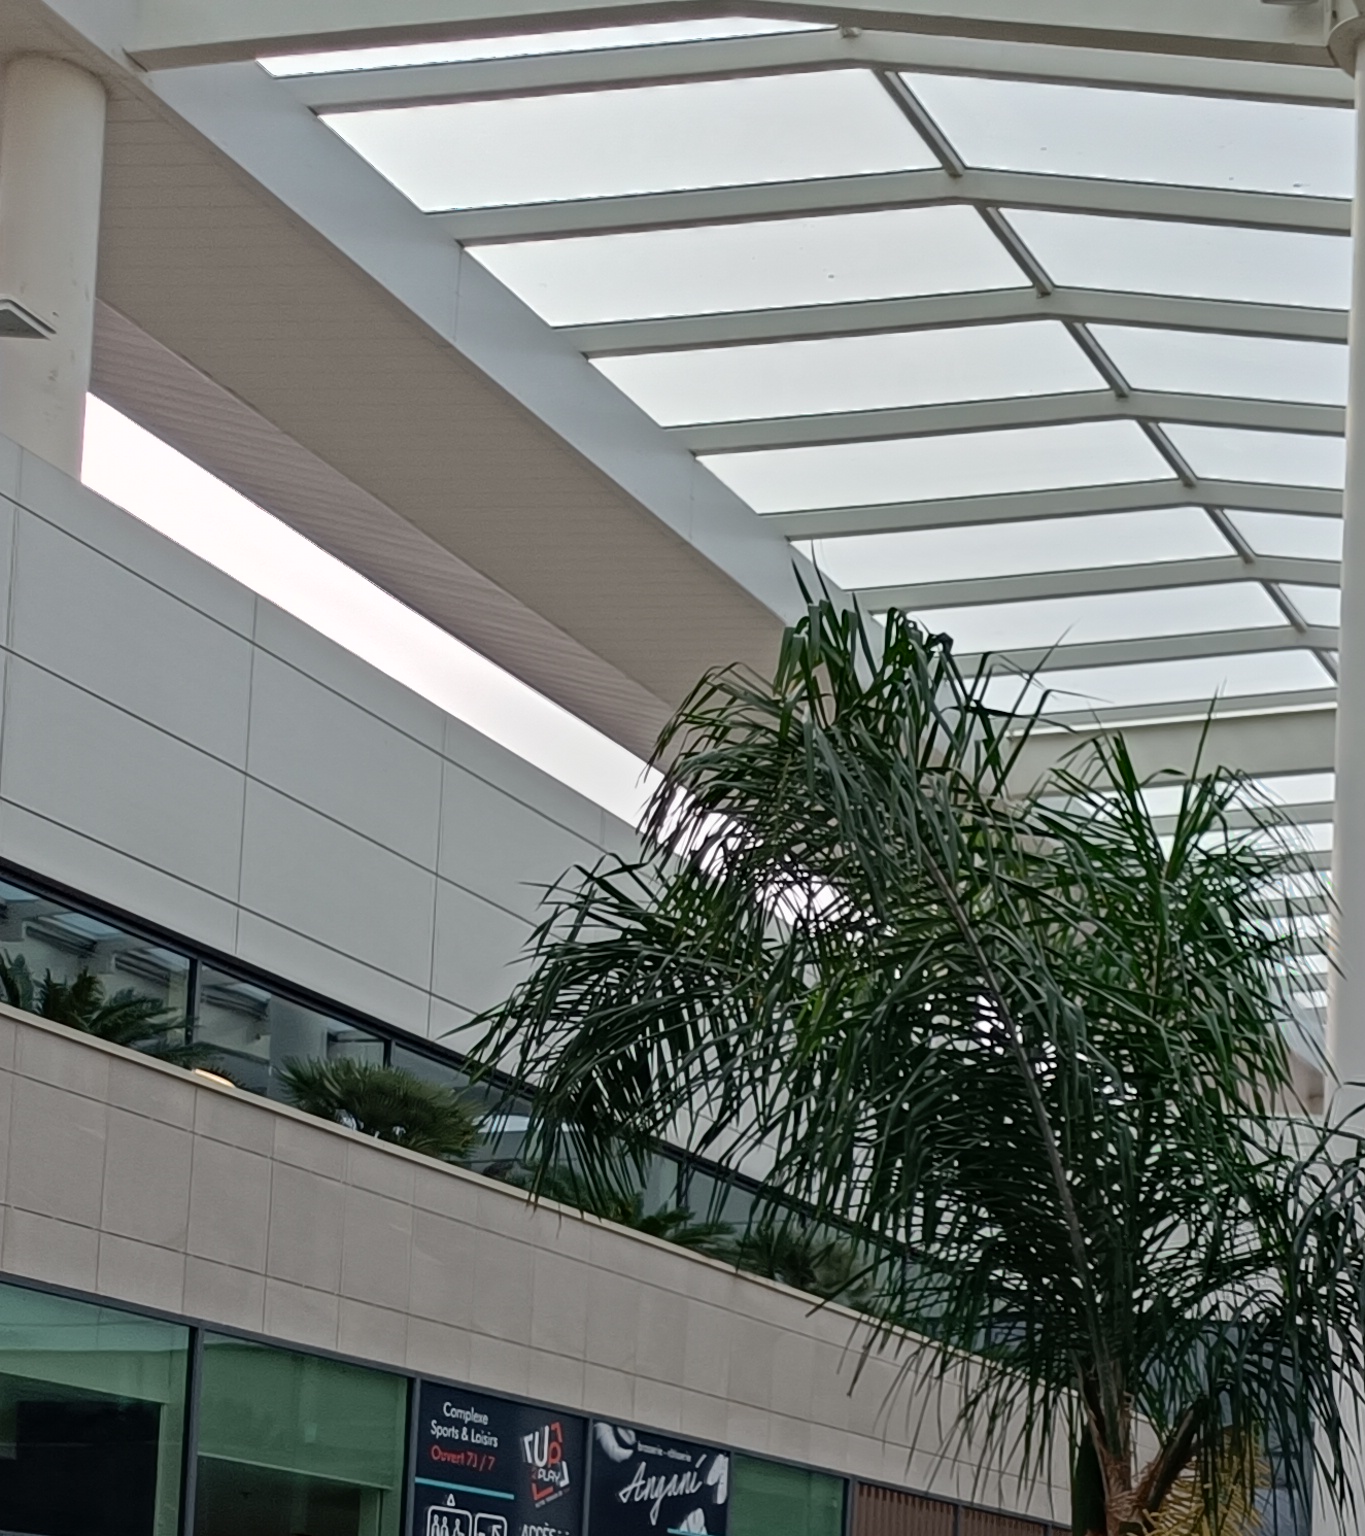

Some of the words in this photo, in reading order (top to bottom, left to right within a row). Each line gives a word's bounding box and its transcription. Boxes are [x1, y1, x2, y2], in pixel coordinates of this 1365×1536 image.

[443, 1402, 488, 1425] Complexe
[430, 1419, 460, 1440] Sports
[461, 1427, 469, 1442] &
[470, 1428, 499, 1448] Loisirs
[431, 1444, 465, 1466] Ouvert
